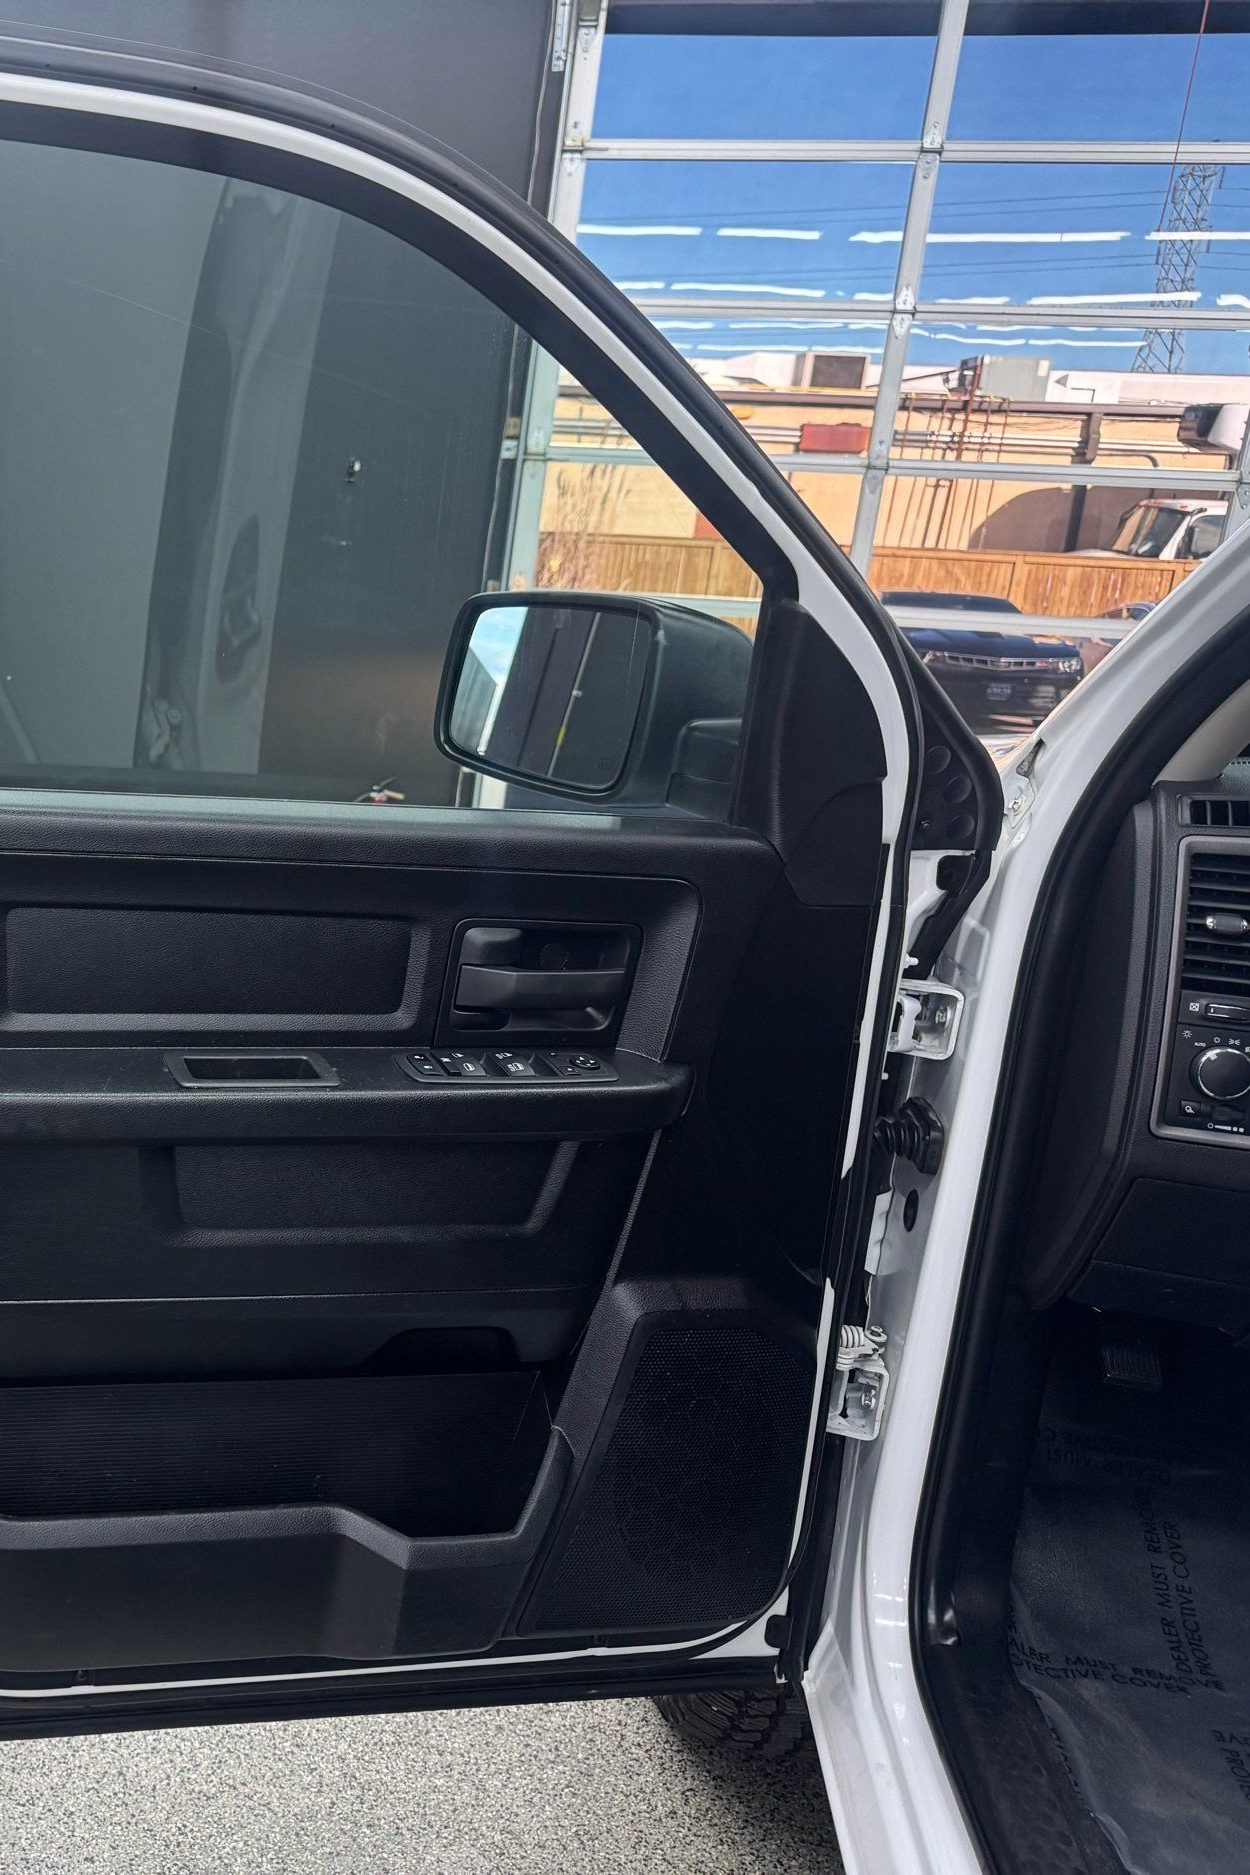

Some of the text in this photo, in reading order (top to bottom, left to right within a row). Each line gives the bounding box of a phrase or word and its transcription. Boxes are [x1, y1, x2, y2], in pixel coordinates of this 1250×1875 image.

[1151, 1563, 1174, 1609] MUST
[1163, 1522, 1218, 1677] PROTECTIVE COVER
[1065, 1656, 1117, 1671] MUST
[1161, 1618, 1194, 1673] DEALER
[1111, 1673, 1190, 1694] COVER
